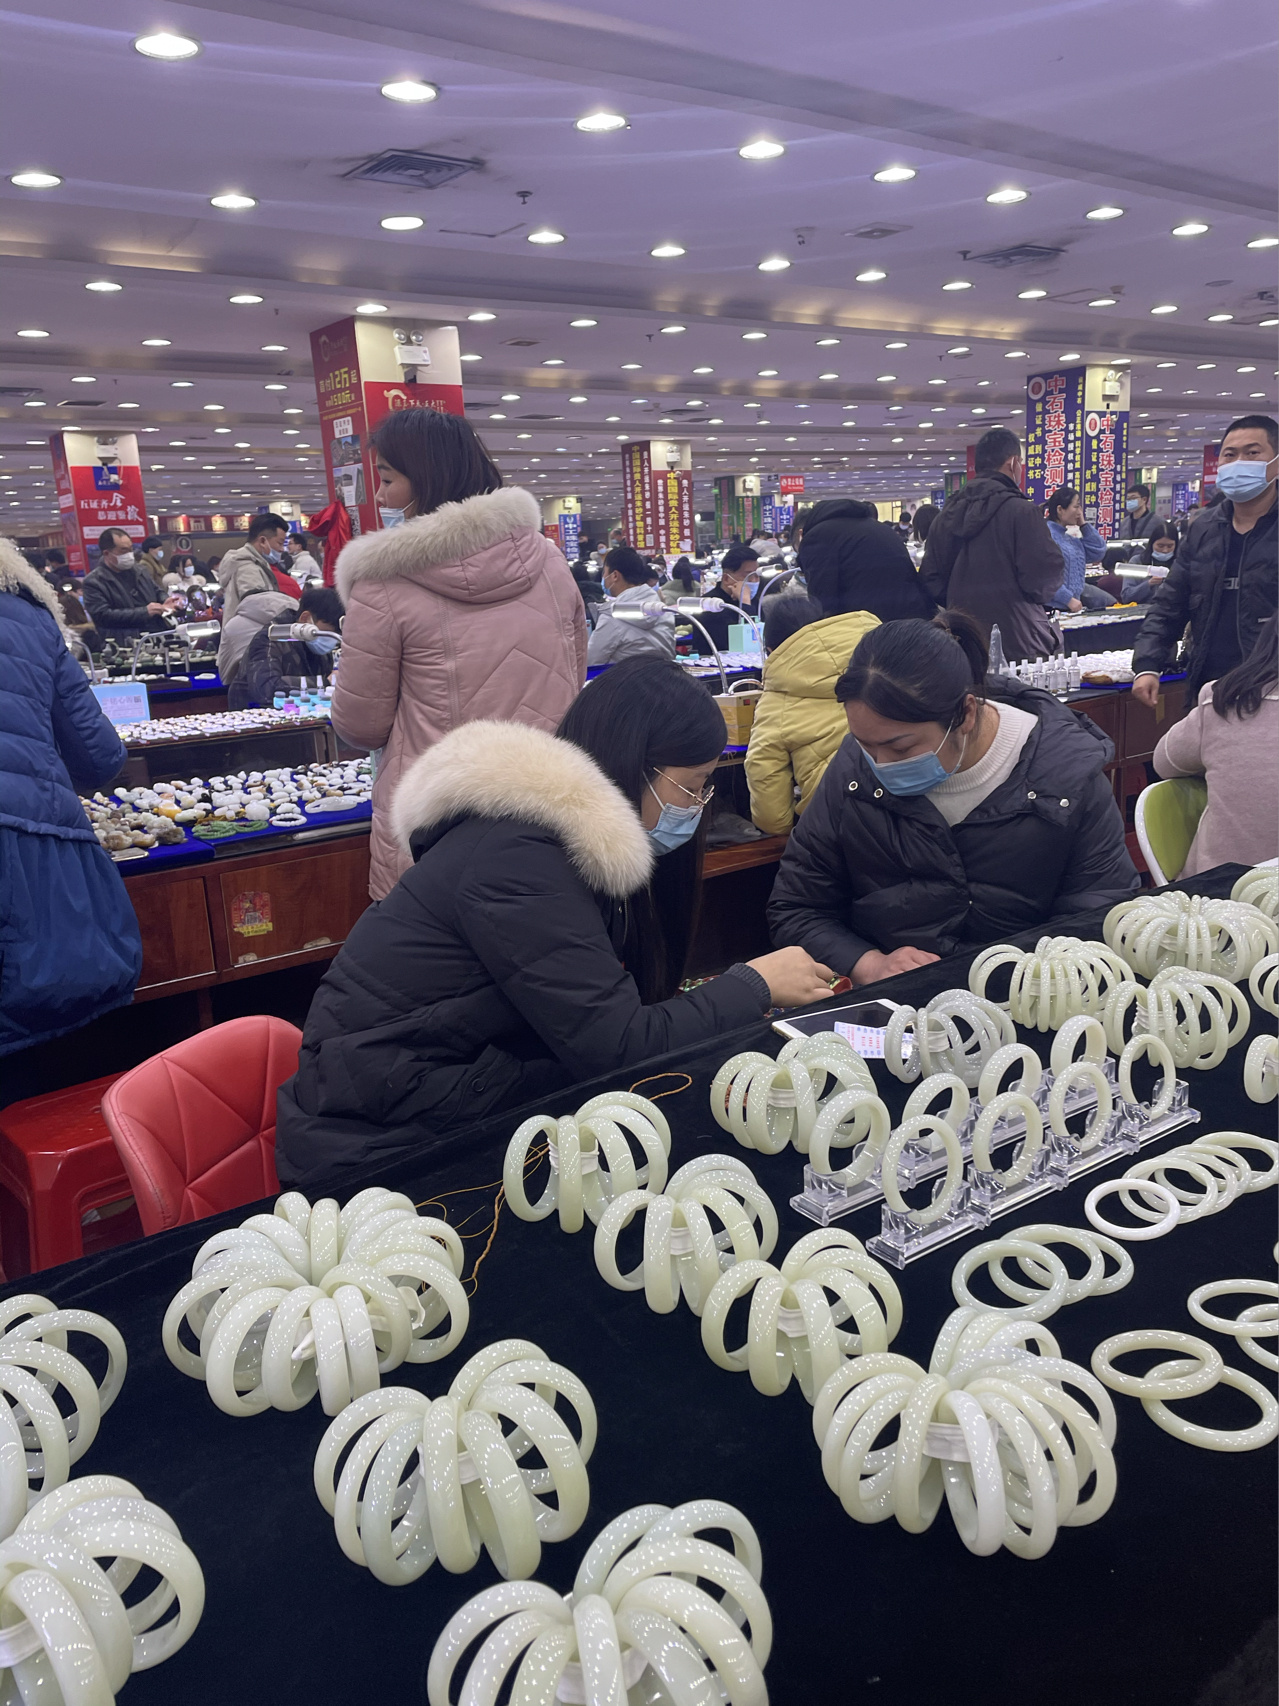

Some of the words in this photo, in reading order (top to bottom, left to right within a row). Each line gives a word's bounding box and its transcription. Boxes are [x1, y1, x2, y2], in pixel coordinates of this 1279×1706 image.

[1098, 414, 1116, 540] 中石珠宝检测中
